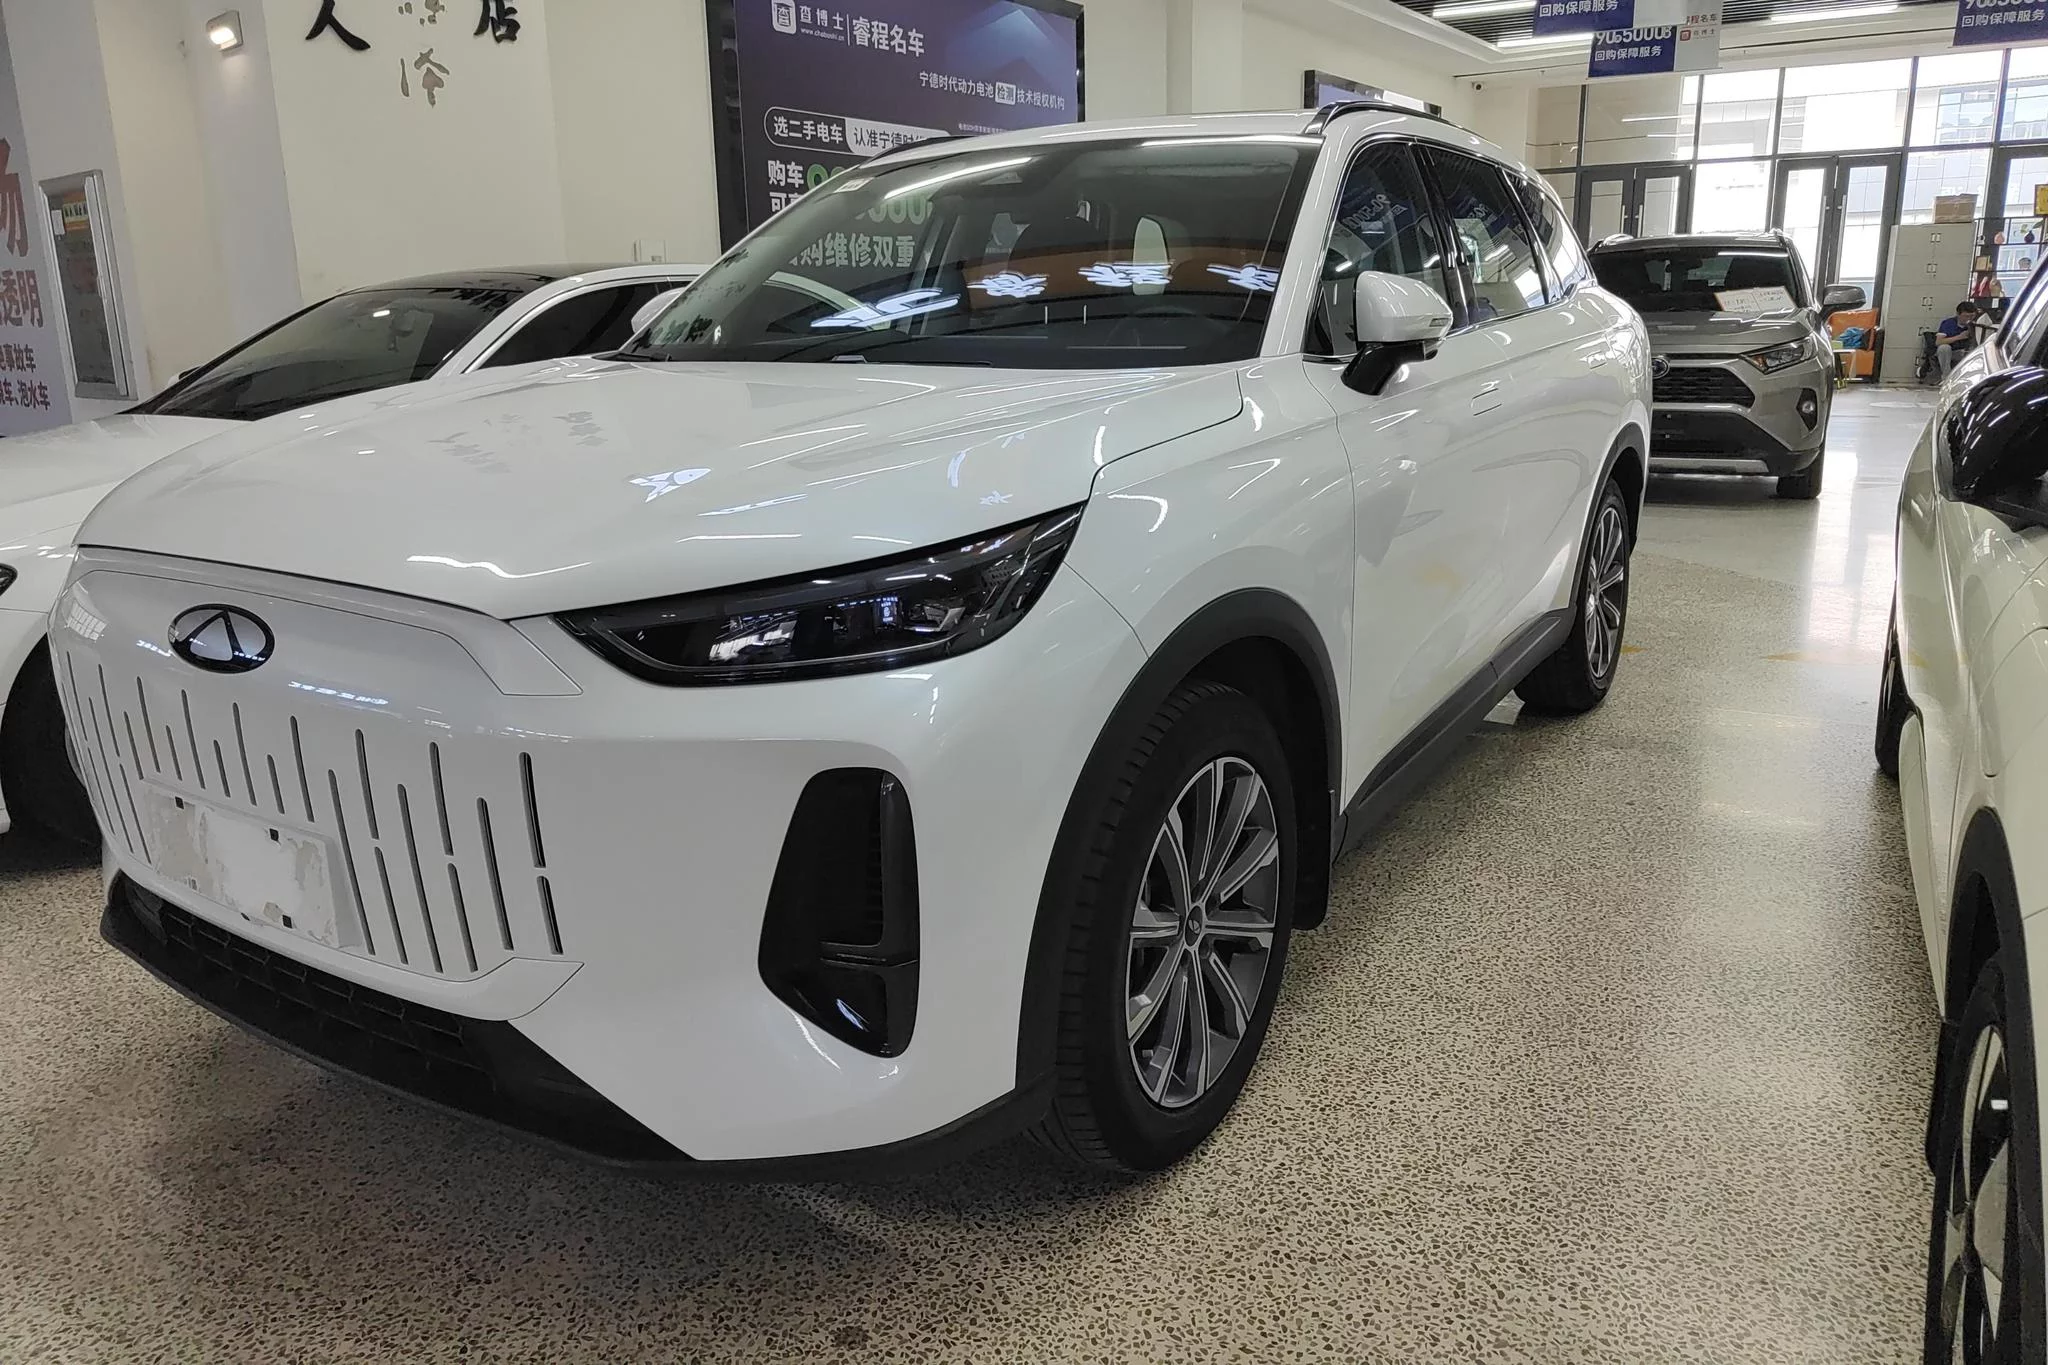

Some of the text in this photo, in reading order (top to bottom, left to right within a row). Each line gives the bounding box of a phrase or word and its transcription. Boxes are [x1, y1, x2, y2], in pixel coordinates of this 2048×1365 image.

[1539, 0, 1619, 18] 回购保障服务
[1961, 9, 2046, 28] 回购保障服务
[799, 5, 925, 57] 查博士 睿程名车
[1594, 45, 1662, 62] 回购保障服务
[919, 70, 995, 98] 宁德时代动力电池
[1016, 88, 1065, 111] 技术授权机构
[773, 115, 921, 149] 选二手电车 认准宁德时
[767, 160, 804, 188] 购车
[789, 232, 915, 268] 购维修双重
